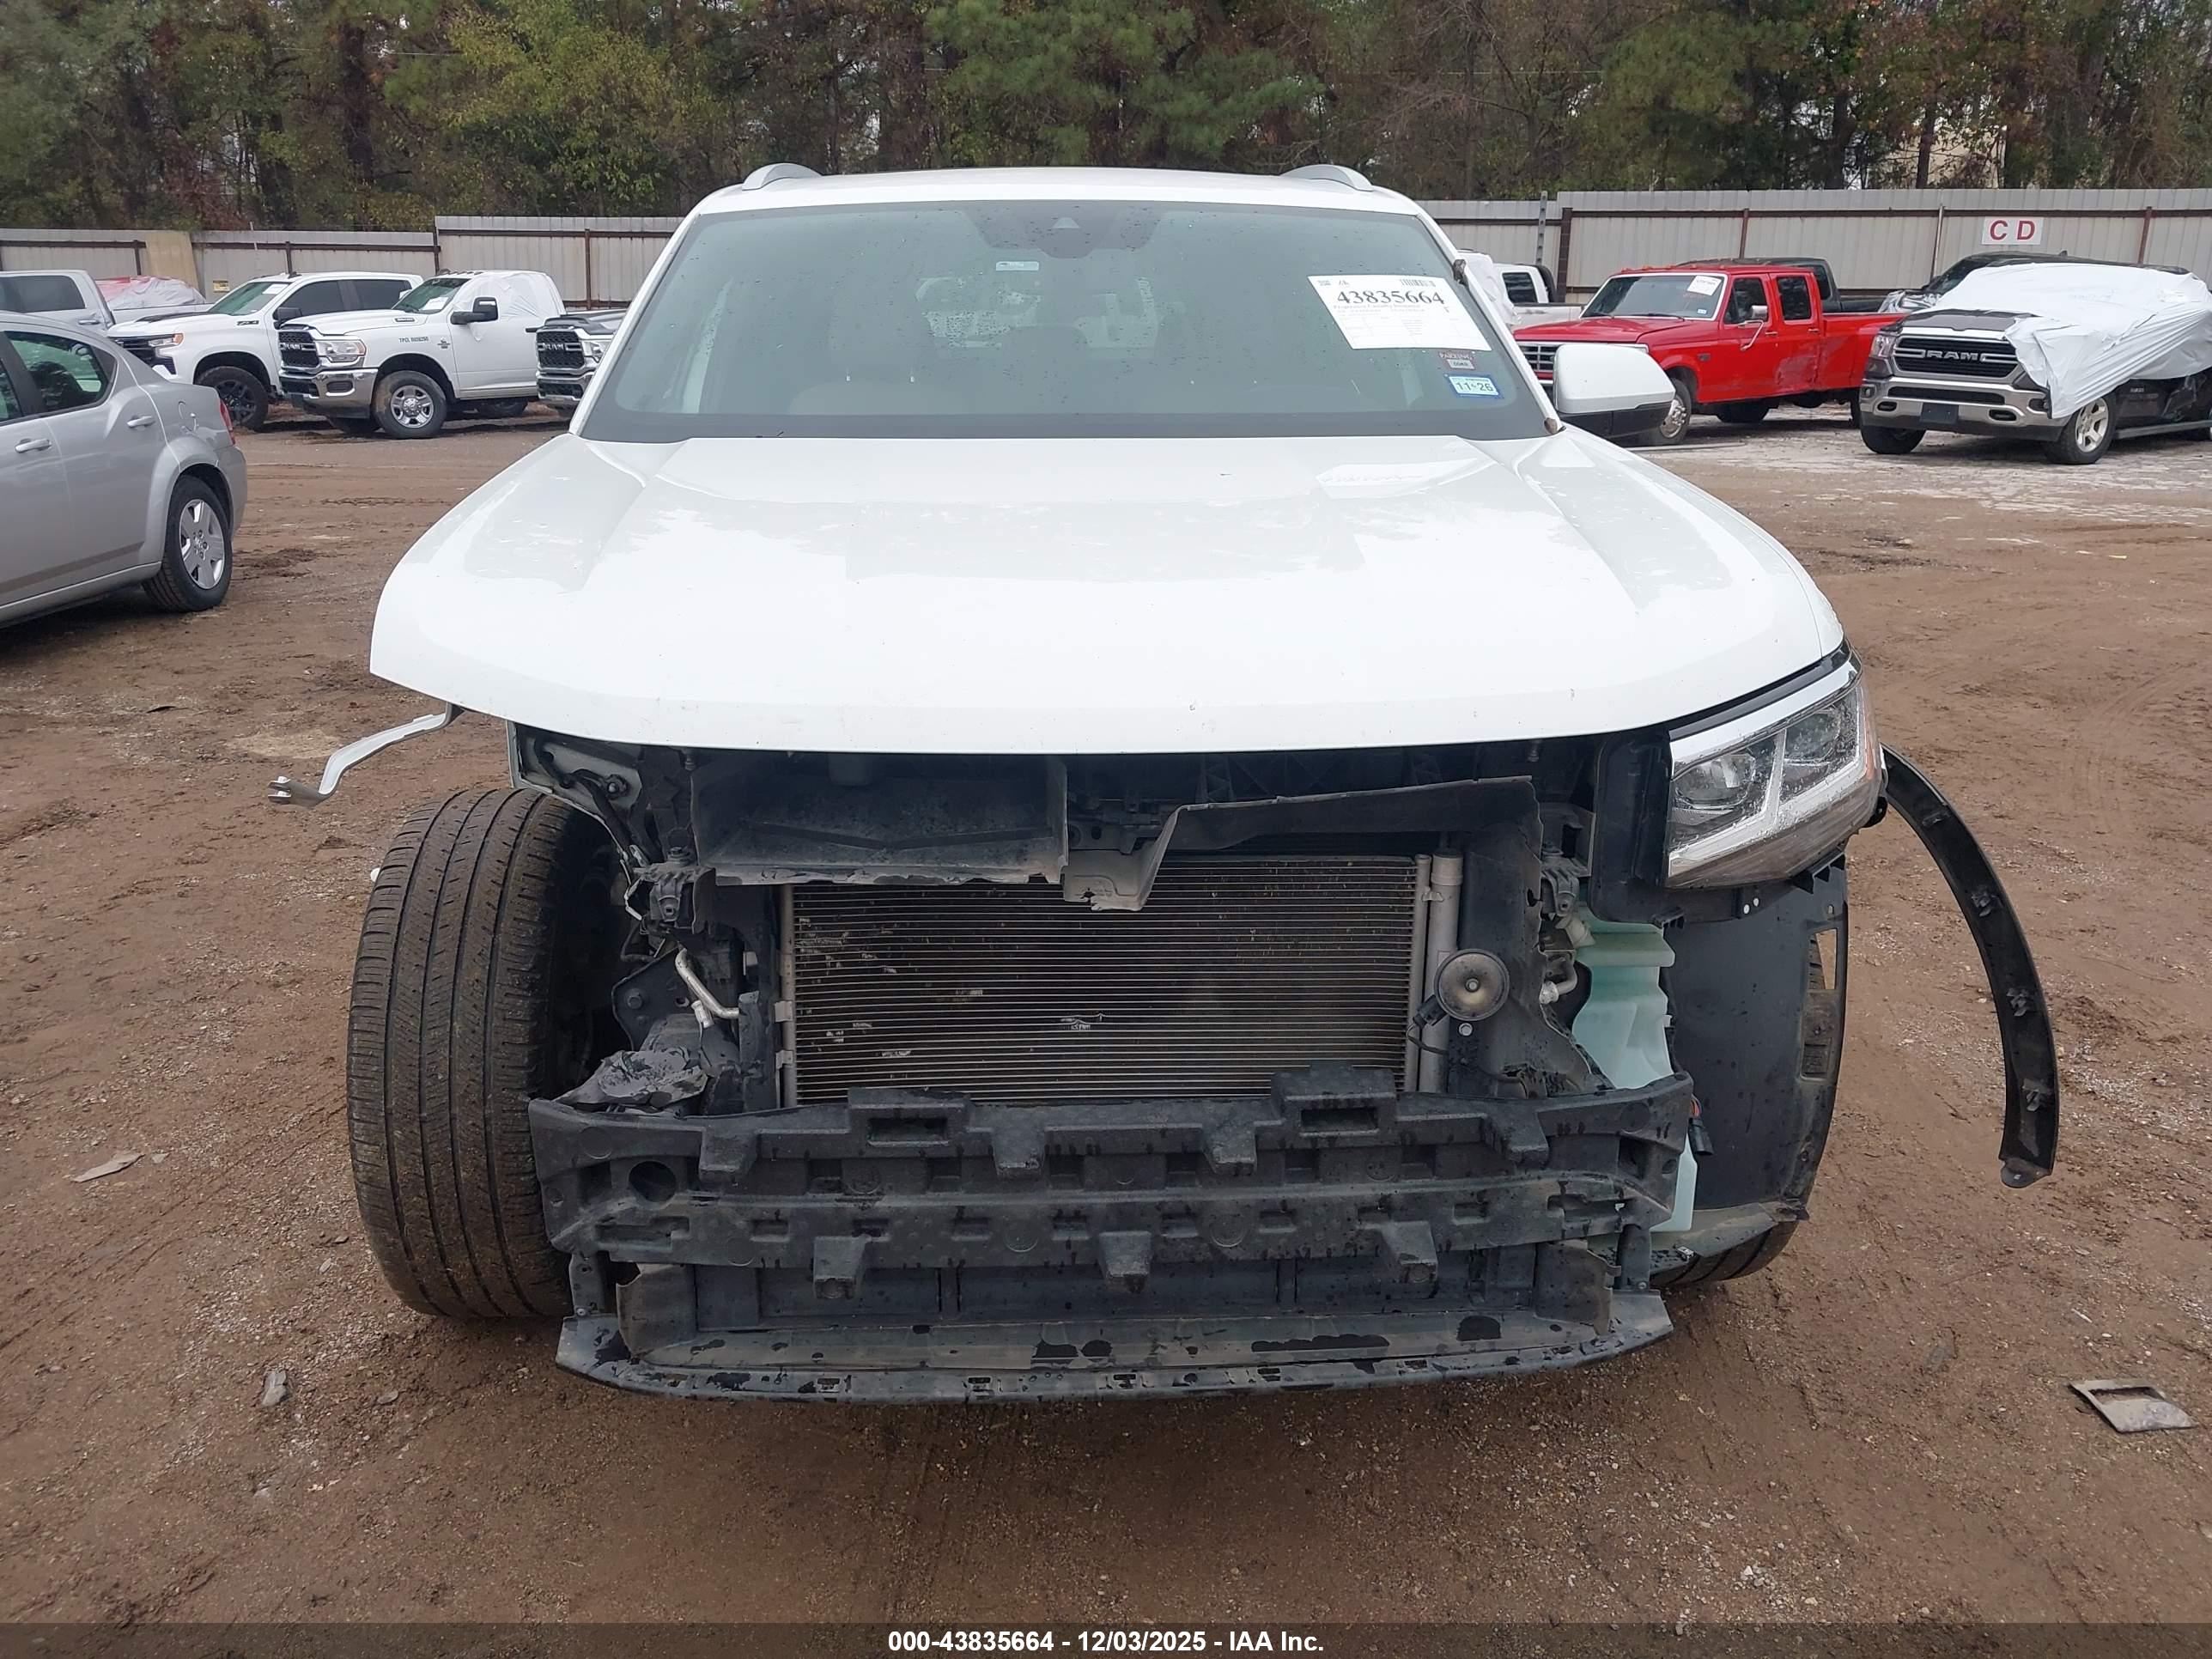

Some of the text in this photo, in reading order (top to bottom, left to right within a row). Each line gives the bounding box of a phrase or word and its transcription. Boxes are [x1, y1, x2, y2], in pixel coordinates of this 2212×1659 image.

[1990, 220, 2036, 240] C D
[1337, 290, 1444, 305] 43835664
[1925, 350, 1978, 362] RAM
[1477, 382, 1494, 392] 26
